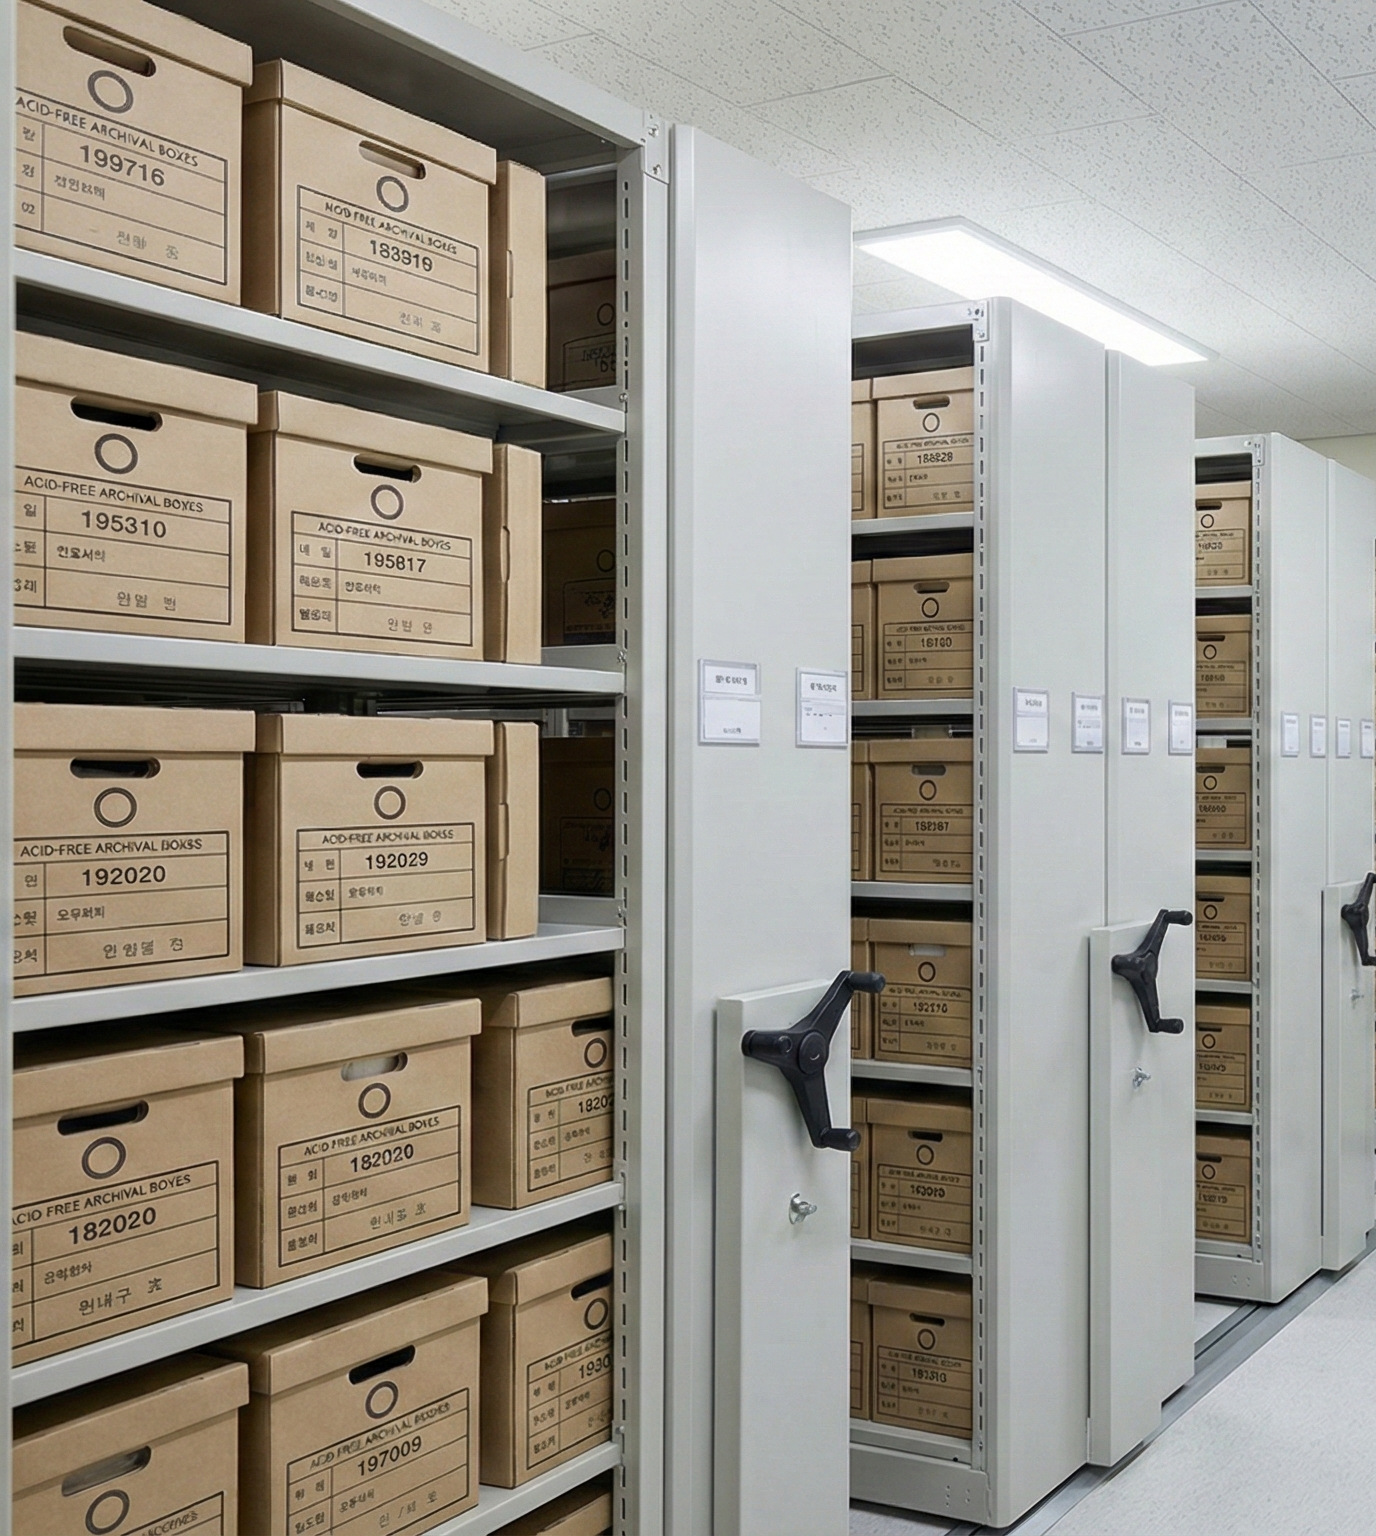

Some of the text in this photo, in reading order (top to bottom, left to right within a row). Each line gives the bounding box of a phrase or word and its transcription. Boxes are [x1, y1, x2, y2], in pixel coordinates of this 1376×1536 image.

[16, 97, 87, 129] ACID-FREE
[90, 122, 156, 153] ARCHIVAL
[80, 145, 165, 187] 199716
[81, 510, 167, 538] 195310
[364, 552, 427, 573] 195817
[82, 865, 167, 886] 192020
[365, 852, 429, 870] 192029
[350, 1143, 415, 1173] 182020
[46, 1200, 80, 1218] FREE
[84, 1184, 147, 1208] ARCHIVAL
[68, 1207, 157, 1245] 182020
[358, 1435, 423, 1477] 197009
